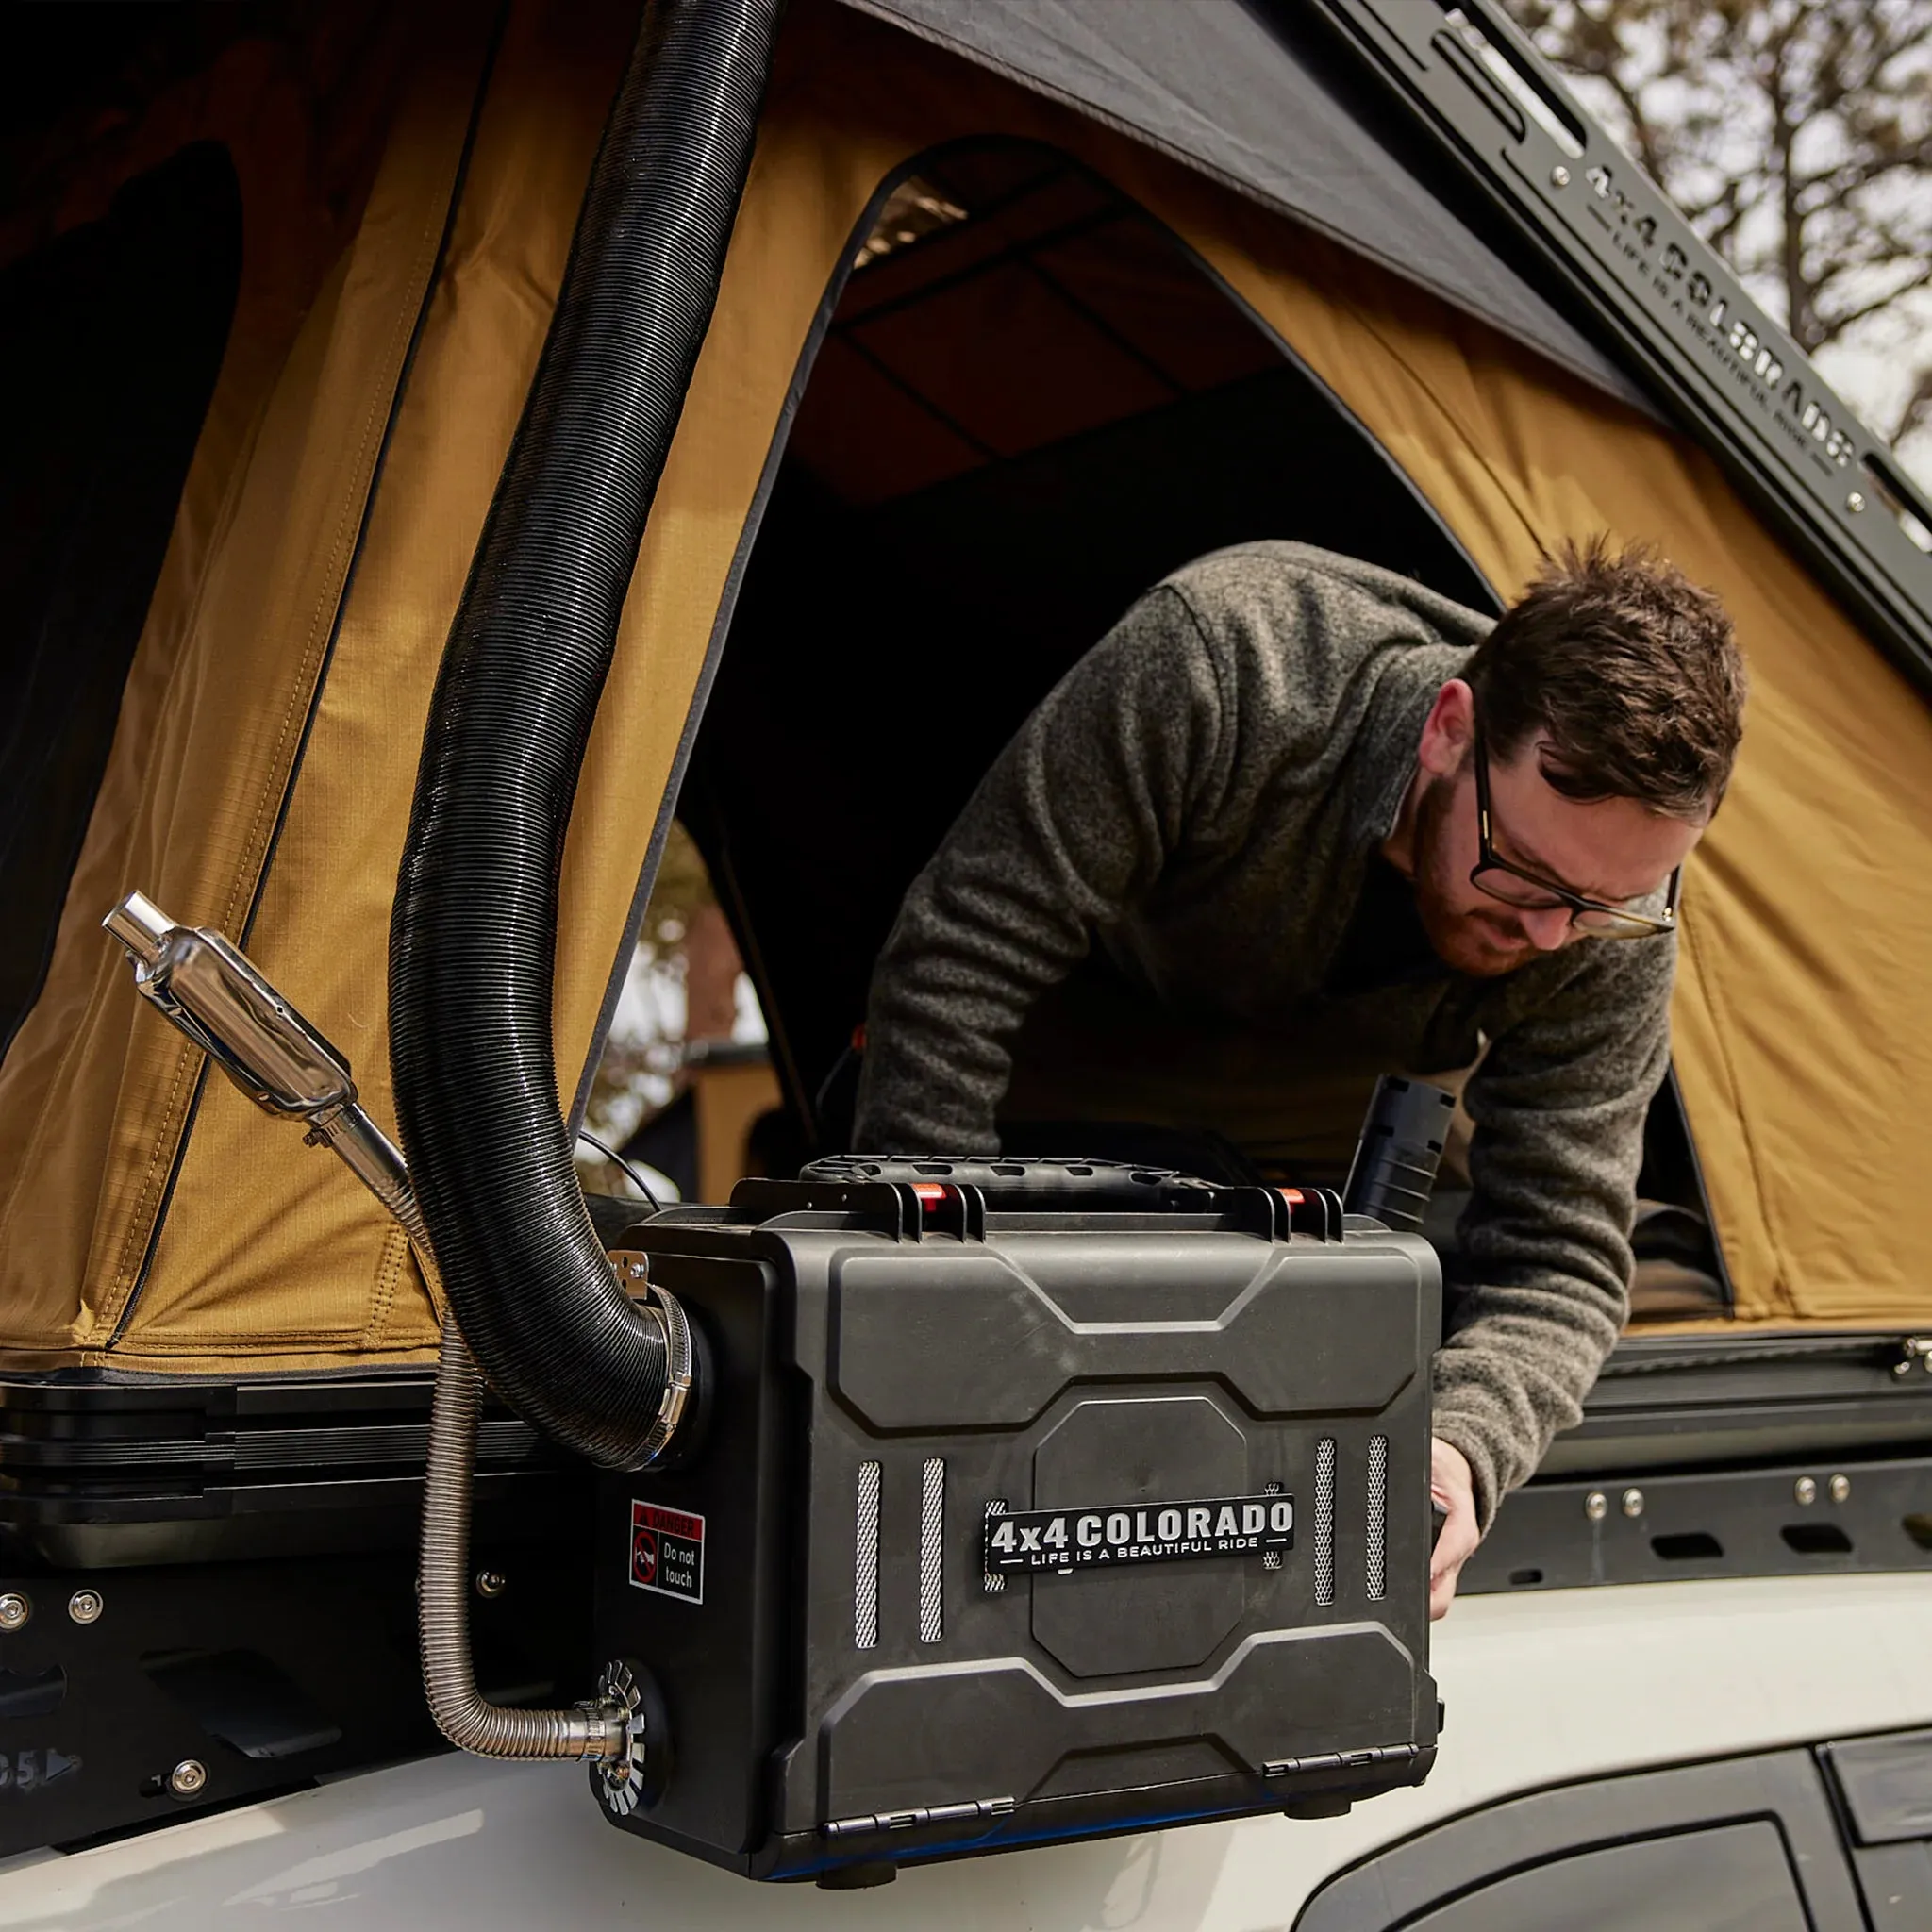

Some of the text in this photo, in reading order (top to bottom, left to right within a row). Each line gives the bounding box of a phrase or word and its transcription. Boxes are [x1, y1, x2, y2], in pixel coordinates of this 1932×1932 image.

[991, 1501, 1293, 1552] 4x4 COLORADO
[664, 1541, 695, 1566] Do not
[1031, 1536, 1257, 1566] LIFE IS A BEAUTIFUL RIDE
[665, 1566, 692, 1589] touch
